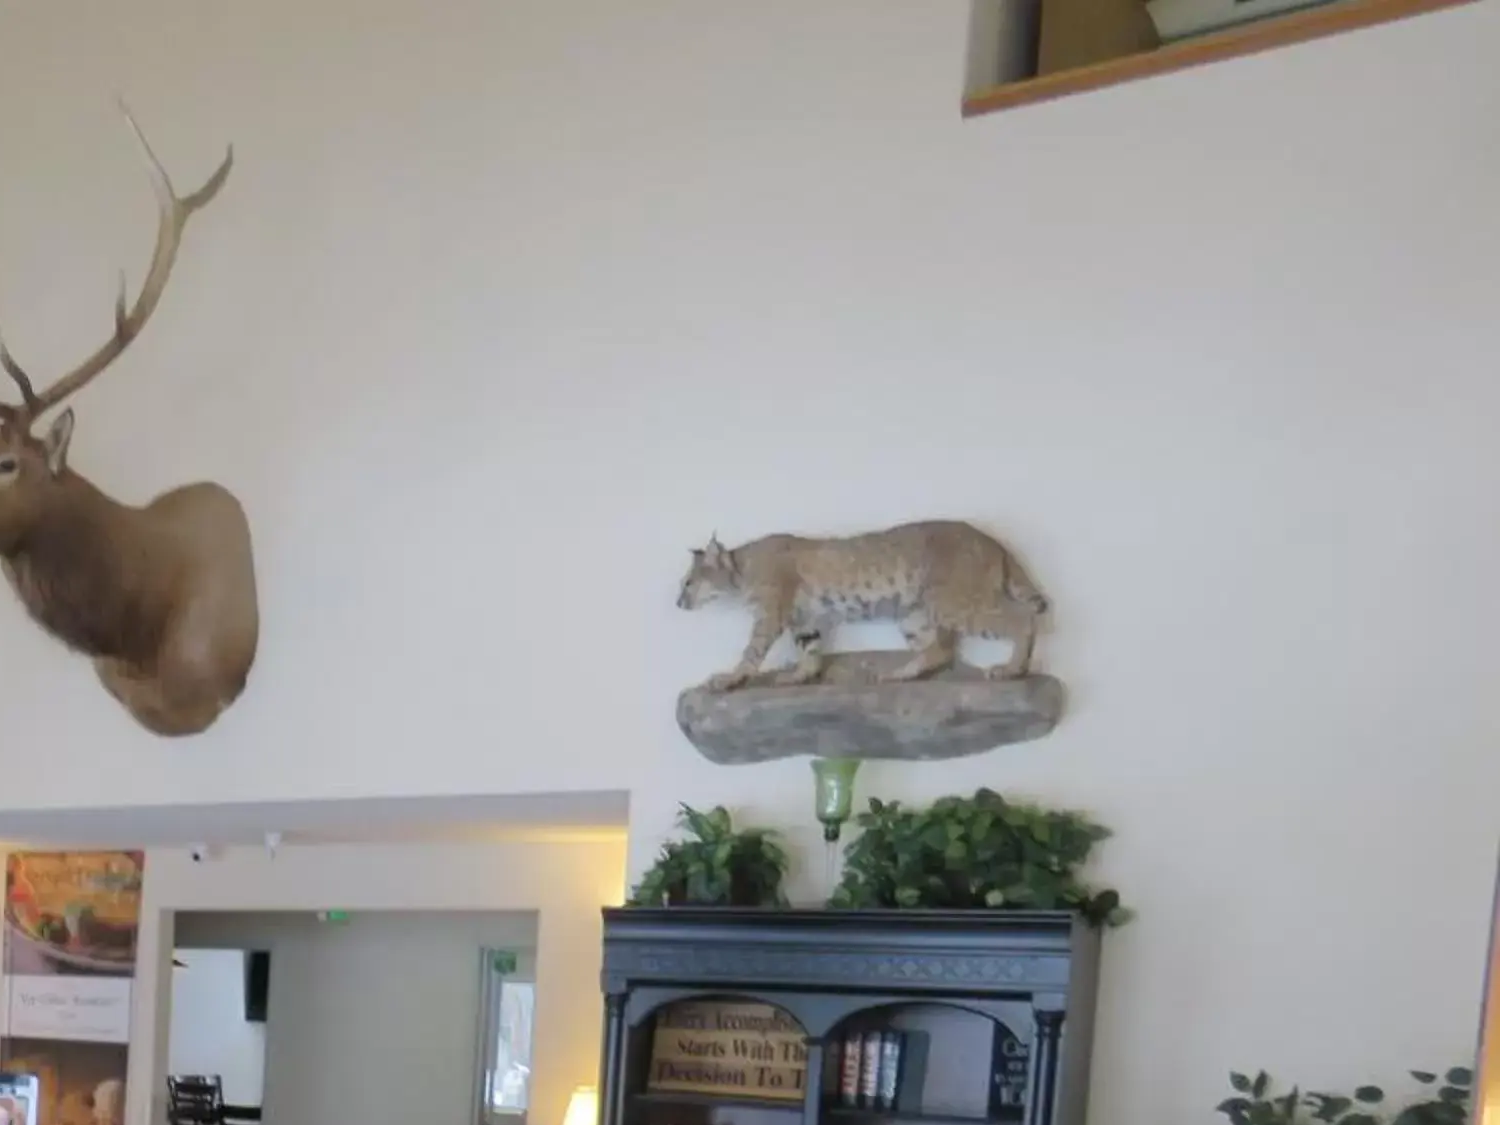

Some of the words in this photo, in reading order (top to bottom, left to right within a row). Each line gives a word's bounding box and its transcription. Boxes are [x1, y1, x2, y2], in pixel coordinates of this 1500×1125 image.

[677, 1037, 725, 1057] Starts
[732, 1038, 775, 1062] With
[657, 1059, 746, 1087] Decision
[754, 1067, 783, 1088] To
